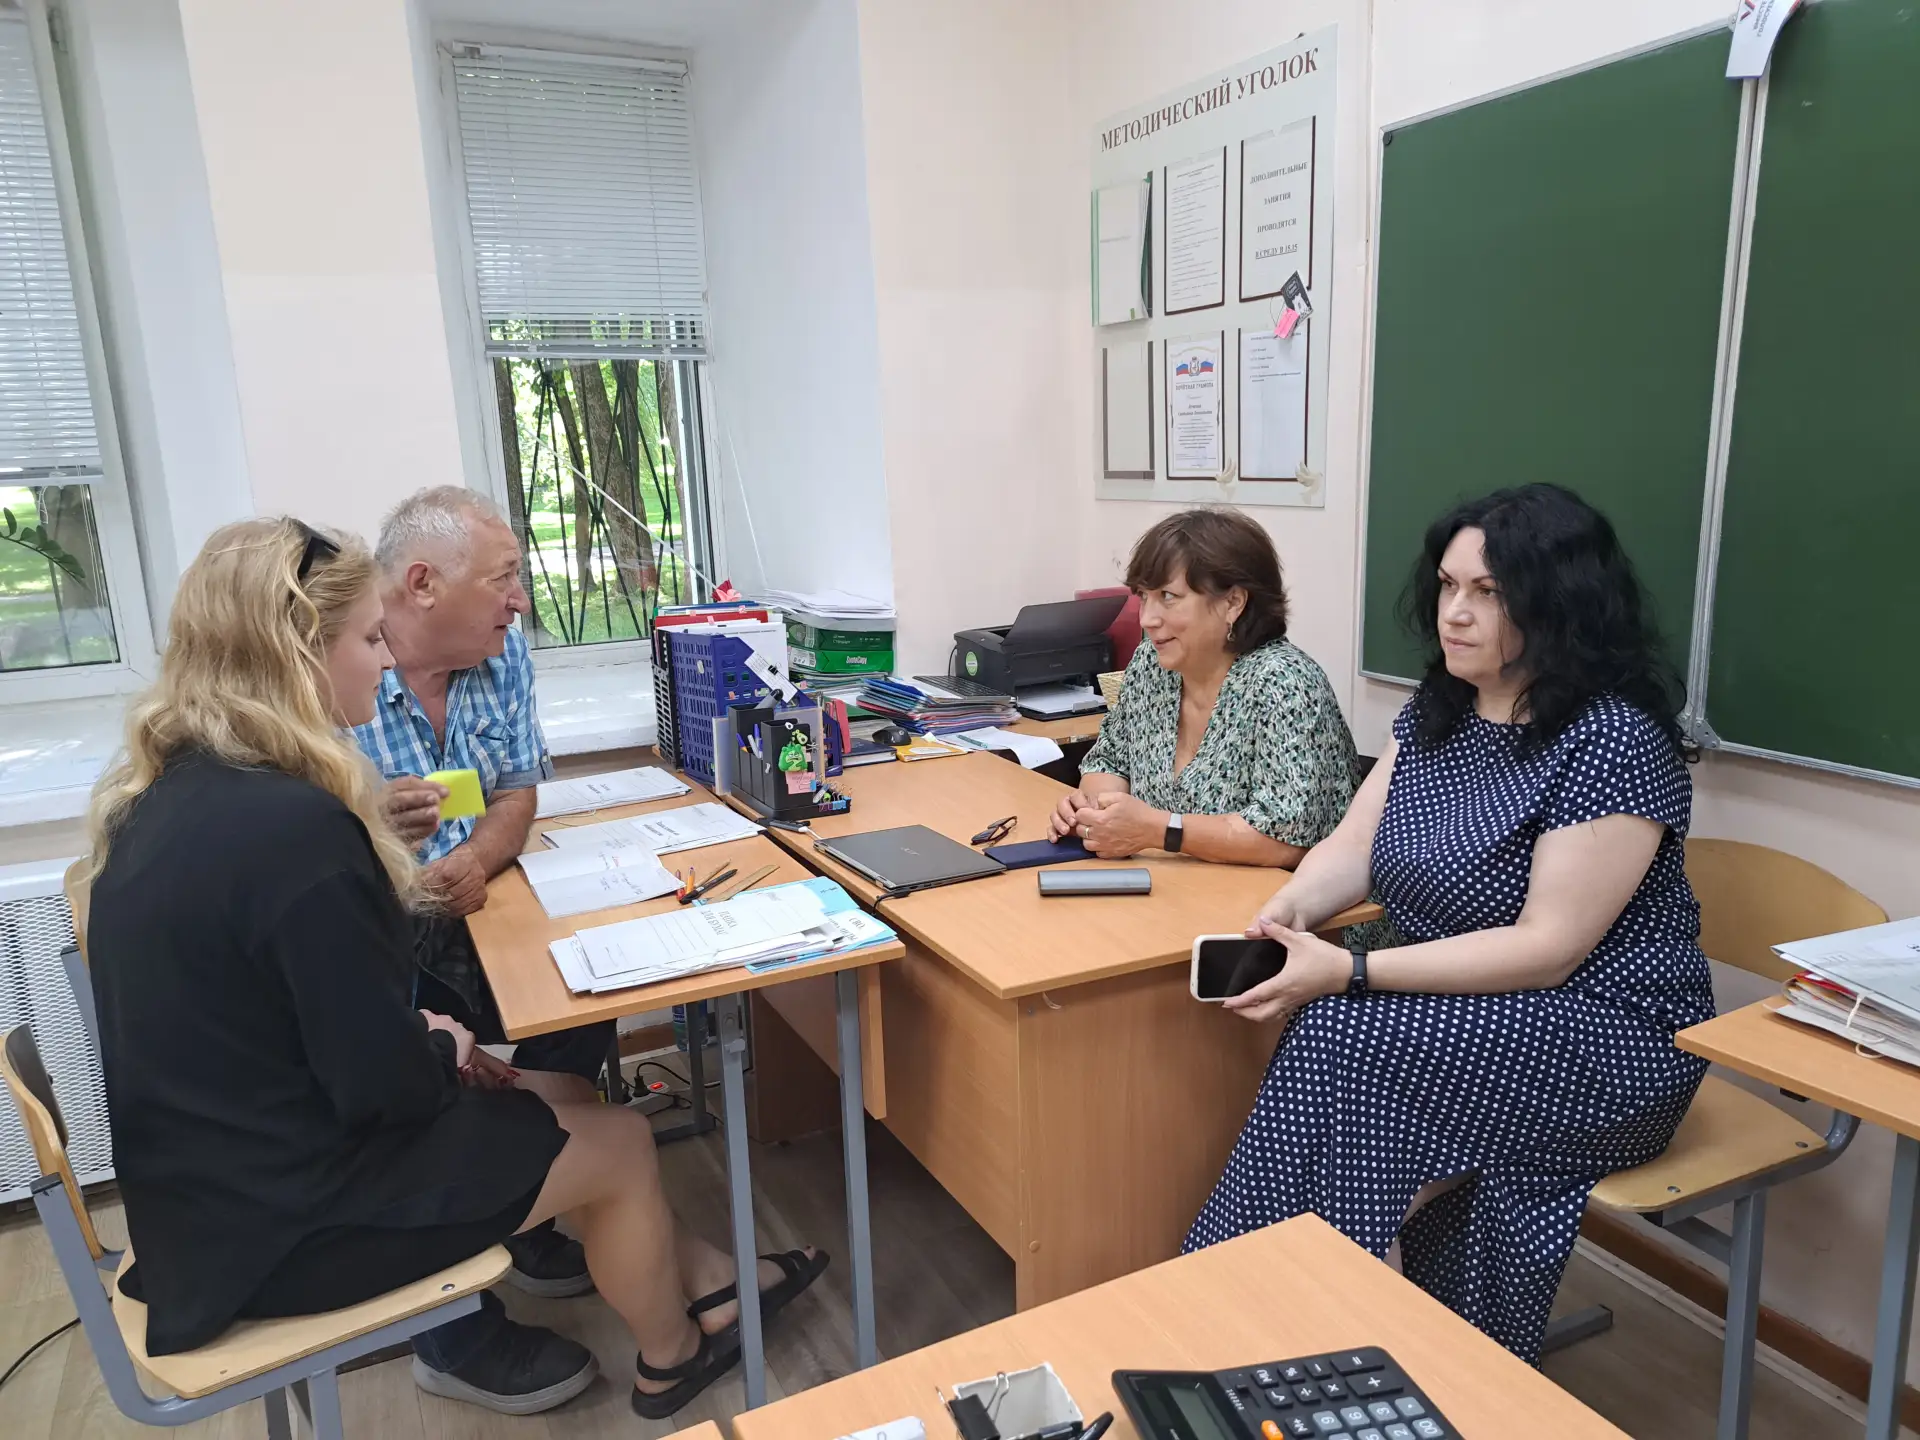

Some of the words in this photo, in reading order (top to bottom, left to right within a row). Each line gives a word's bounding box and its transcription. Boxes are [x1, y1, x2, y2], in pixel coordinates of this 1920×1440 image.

[1101, 77, 1231, 152] МЕТОДИЧЕСКИЙ
[1237, 48, 1319, 99] УГОЛОК
[1250, 161, 1308, 184] ДОПОЛНИТЕЛЬНЫЕ
[1264, 192, 1292, 205] ЗАНЯТИЯ
[1257, 218, 1297, 233] ПРОВОДЯТСЯ
[1260, 247, 1279, 258] СРЕДУ
[1280, 246, 1285, 255] В
[1349, 1411, 1362, 1420] 6
[1376, 1407, 1390, 1416] 3
[1320, 1416, 1335, 1425] 9
[1393, 1429, 1409, 1438] 2
[1418, 1420, 1438, 1435] 00
